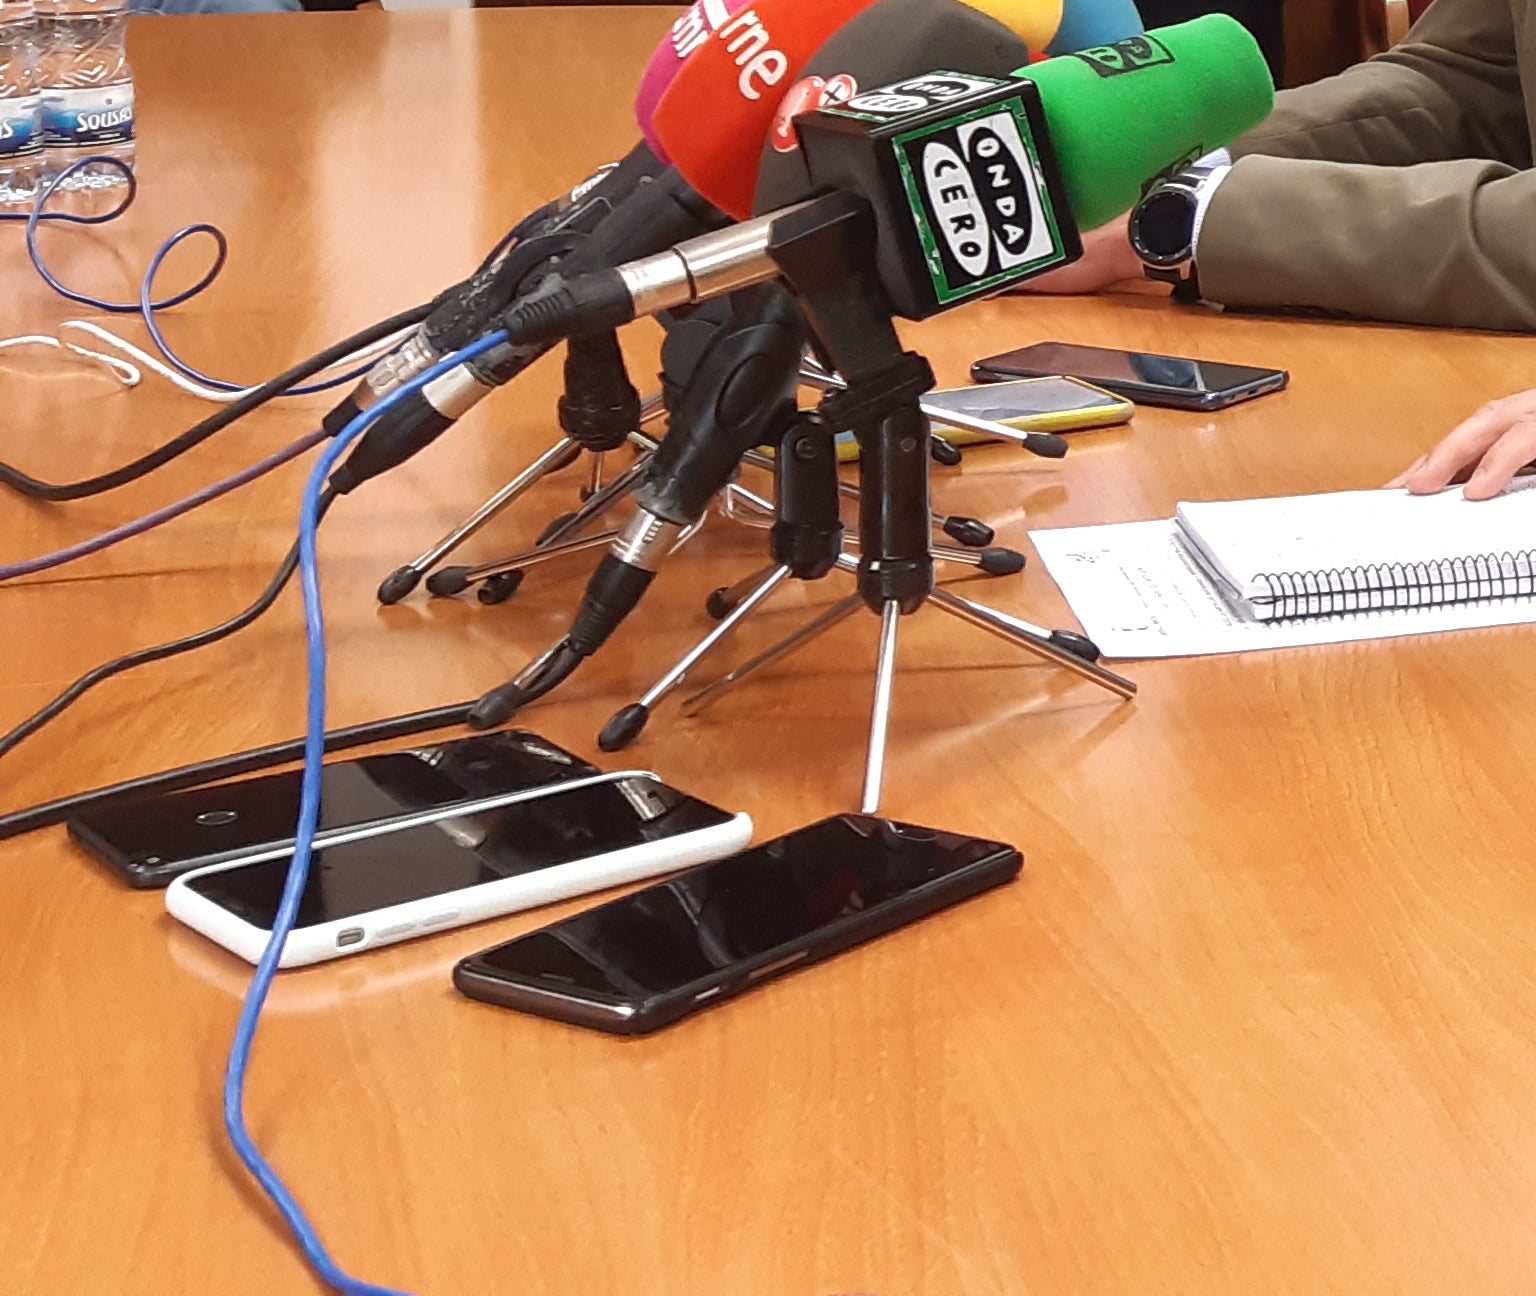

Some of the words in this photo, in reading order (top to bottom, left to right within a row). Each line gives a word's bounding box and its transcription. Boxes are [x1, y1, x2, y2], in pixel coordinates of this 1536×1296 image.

[719, 10, 788, 101] rne
[902, 81, 962, 96] ONDA
[934, 159, 982, 257] CERO
[975, 137, 1024, 245] ONDA
